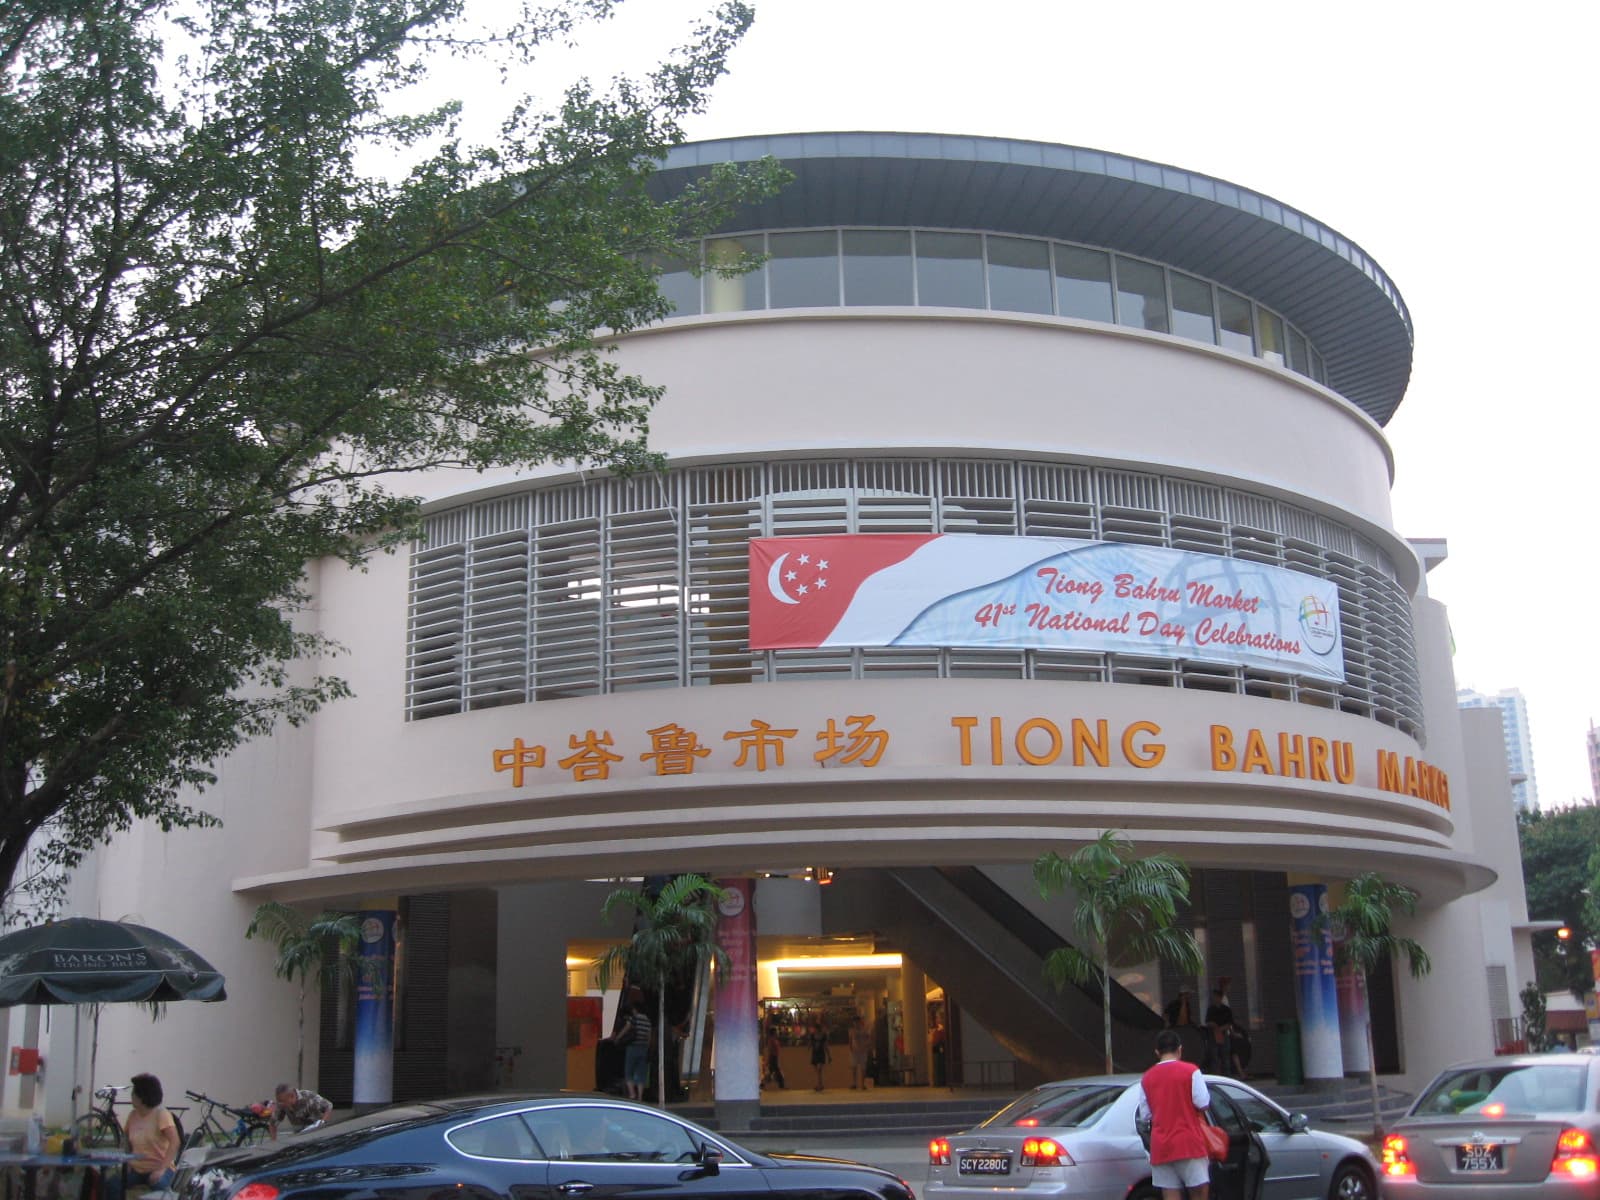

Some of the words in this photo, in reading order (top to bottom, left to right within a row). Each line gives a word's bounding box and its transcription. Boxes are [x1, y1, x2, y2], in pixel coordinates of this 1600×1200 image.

[1037, 567, 1104, 603] Tiong
[1113, 573, 1181, 603] Bahru
[1186, 581, 1260, 614] Market
[974, 603, 1017, 628] 41st
[1024, 603, 1130, 635] National
[1137, 611, 1186, 645] Day
[1195, 617, 1302, 655] Celebrations
[492, 714, 890, 788] 中峇鲁市场
[951, 716, 1167, 768] TIONG
[1210, 724, 1356, 785] BAHRU
[1376, 748, 1451, 812] MARKE
[54, 952, 147, 962] BARON'S
[1462, 1158, 1498, 1170] 755X
